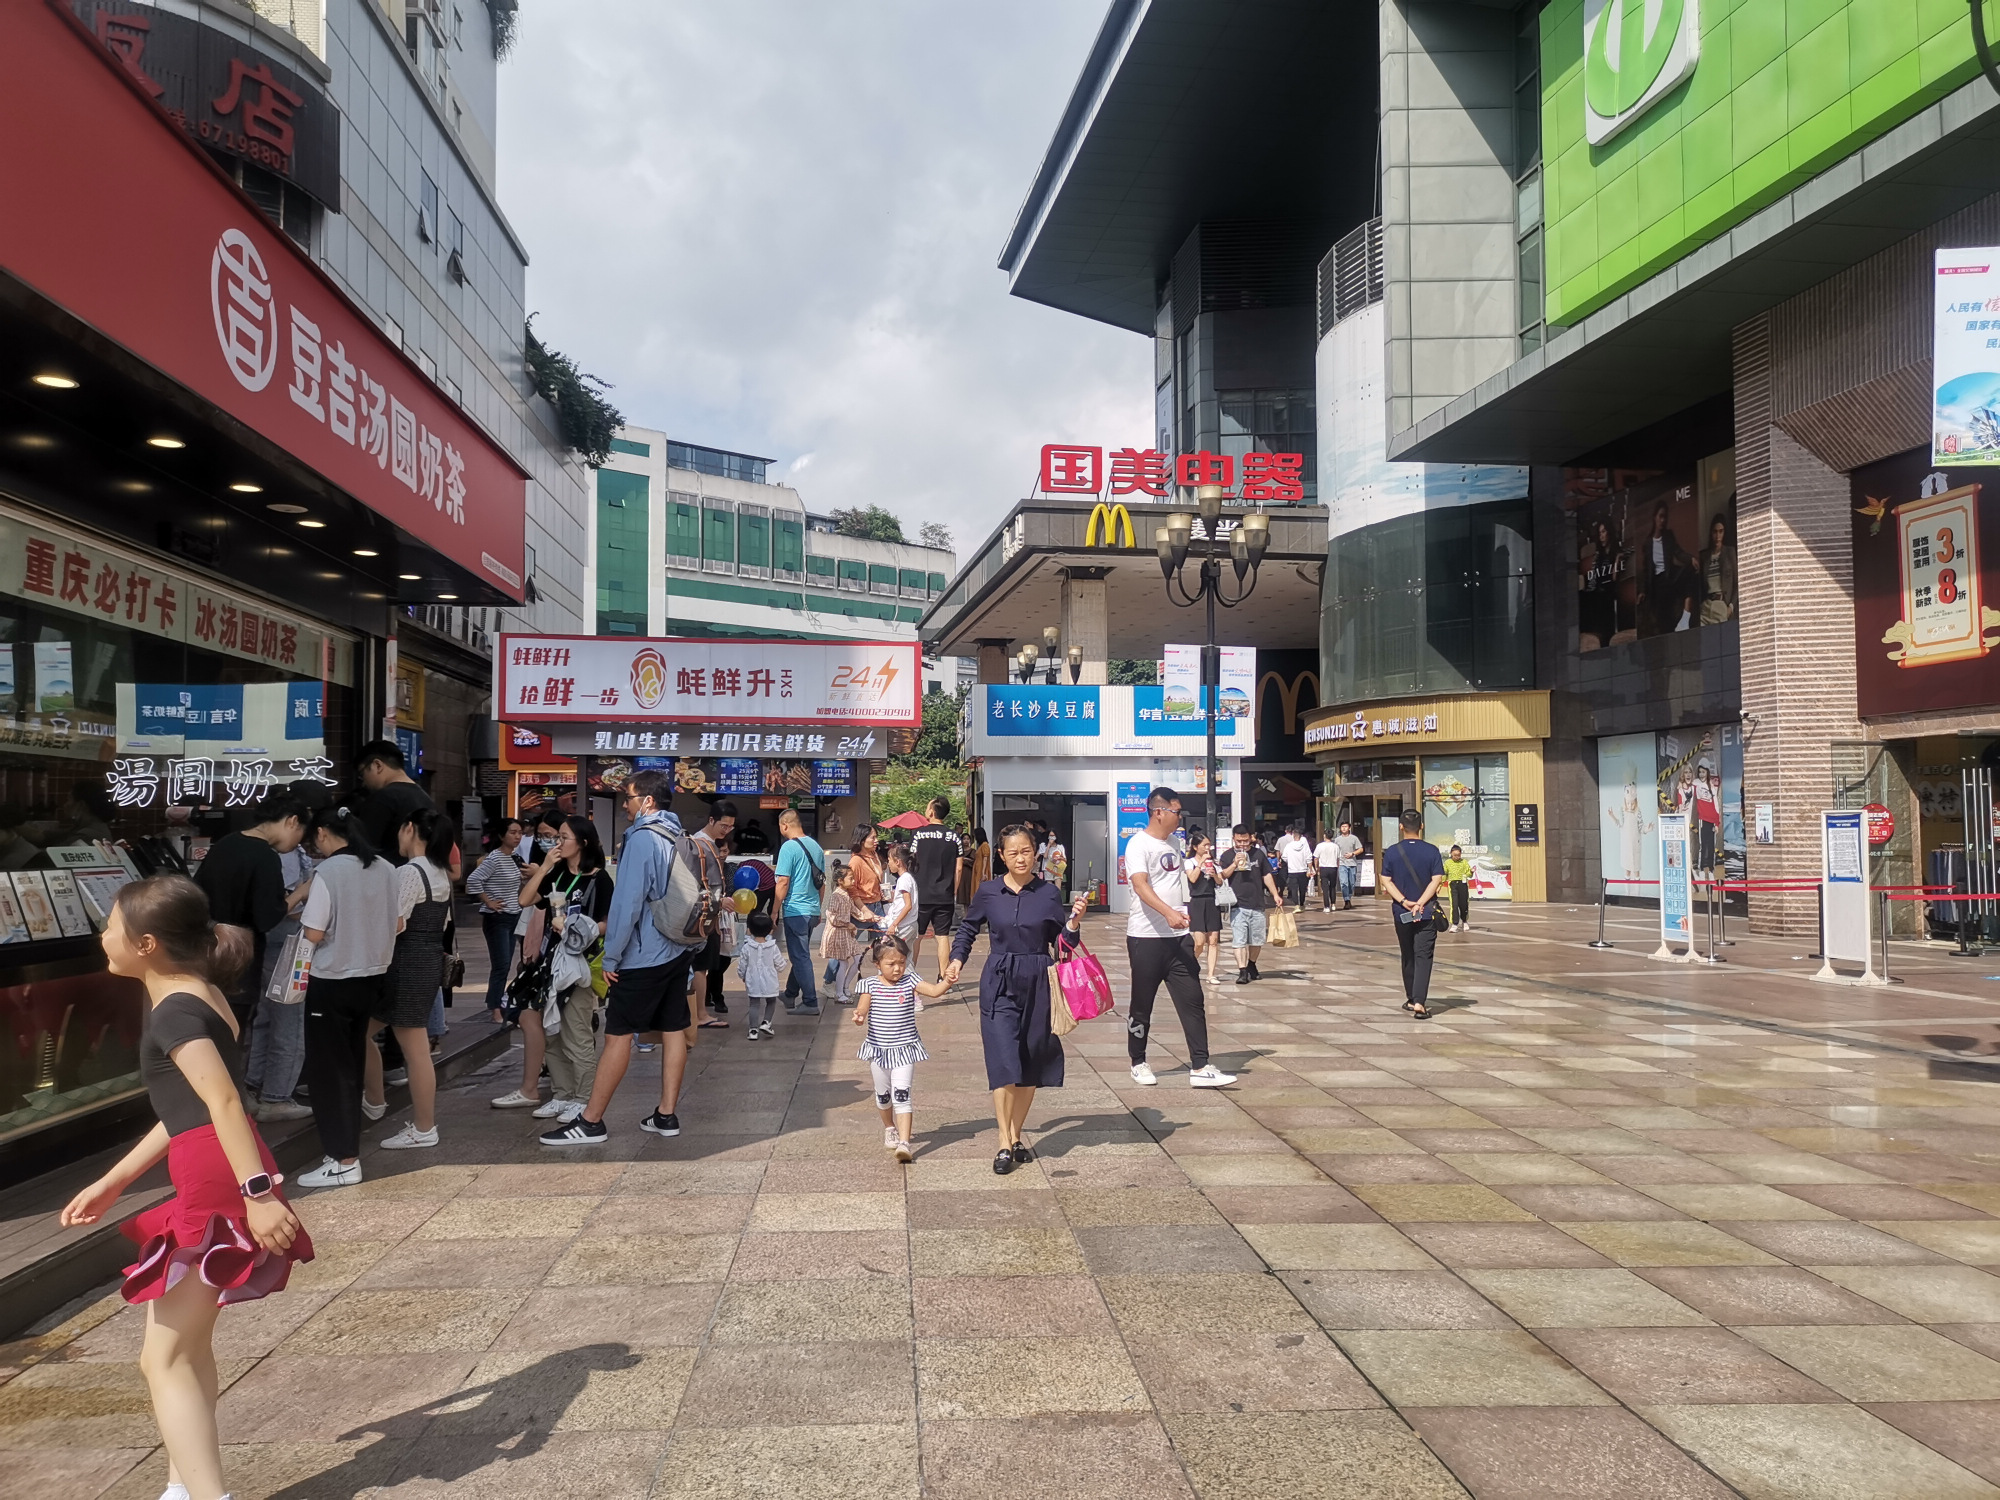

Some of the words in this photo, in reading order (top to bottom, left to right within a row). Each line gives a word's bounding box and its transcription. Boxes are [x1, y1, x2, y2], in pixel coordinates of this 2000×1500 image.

[288, 303, 467, 526] 豆吉汤圆奶茶
[1040, 444, 1304, 500] 国美电器
[23, 536, 178, 631] 重庆必打卡
[1587, 561, 1626, 581] DAZZLE
[195, 597, 298, 665] 冰汤圆奶茶
[512, 647, 571, 667] 蚝鲜升
[519, 677, 620, 707] 抢鲜一步
[676, 667, 776, 698] 蚝鲜升
[780, 669, 793, 698] HXS
[992, 699, 1096, 720] 老长沙臭豆腐
[594, 731, 680, 751] 乳山生蚝
[699, 732, 826, 753] 我们只卖鲜货
